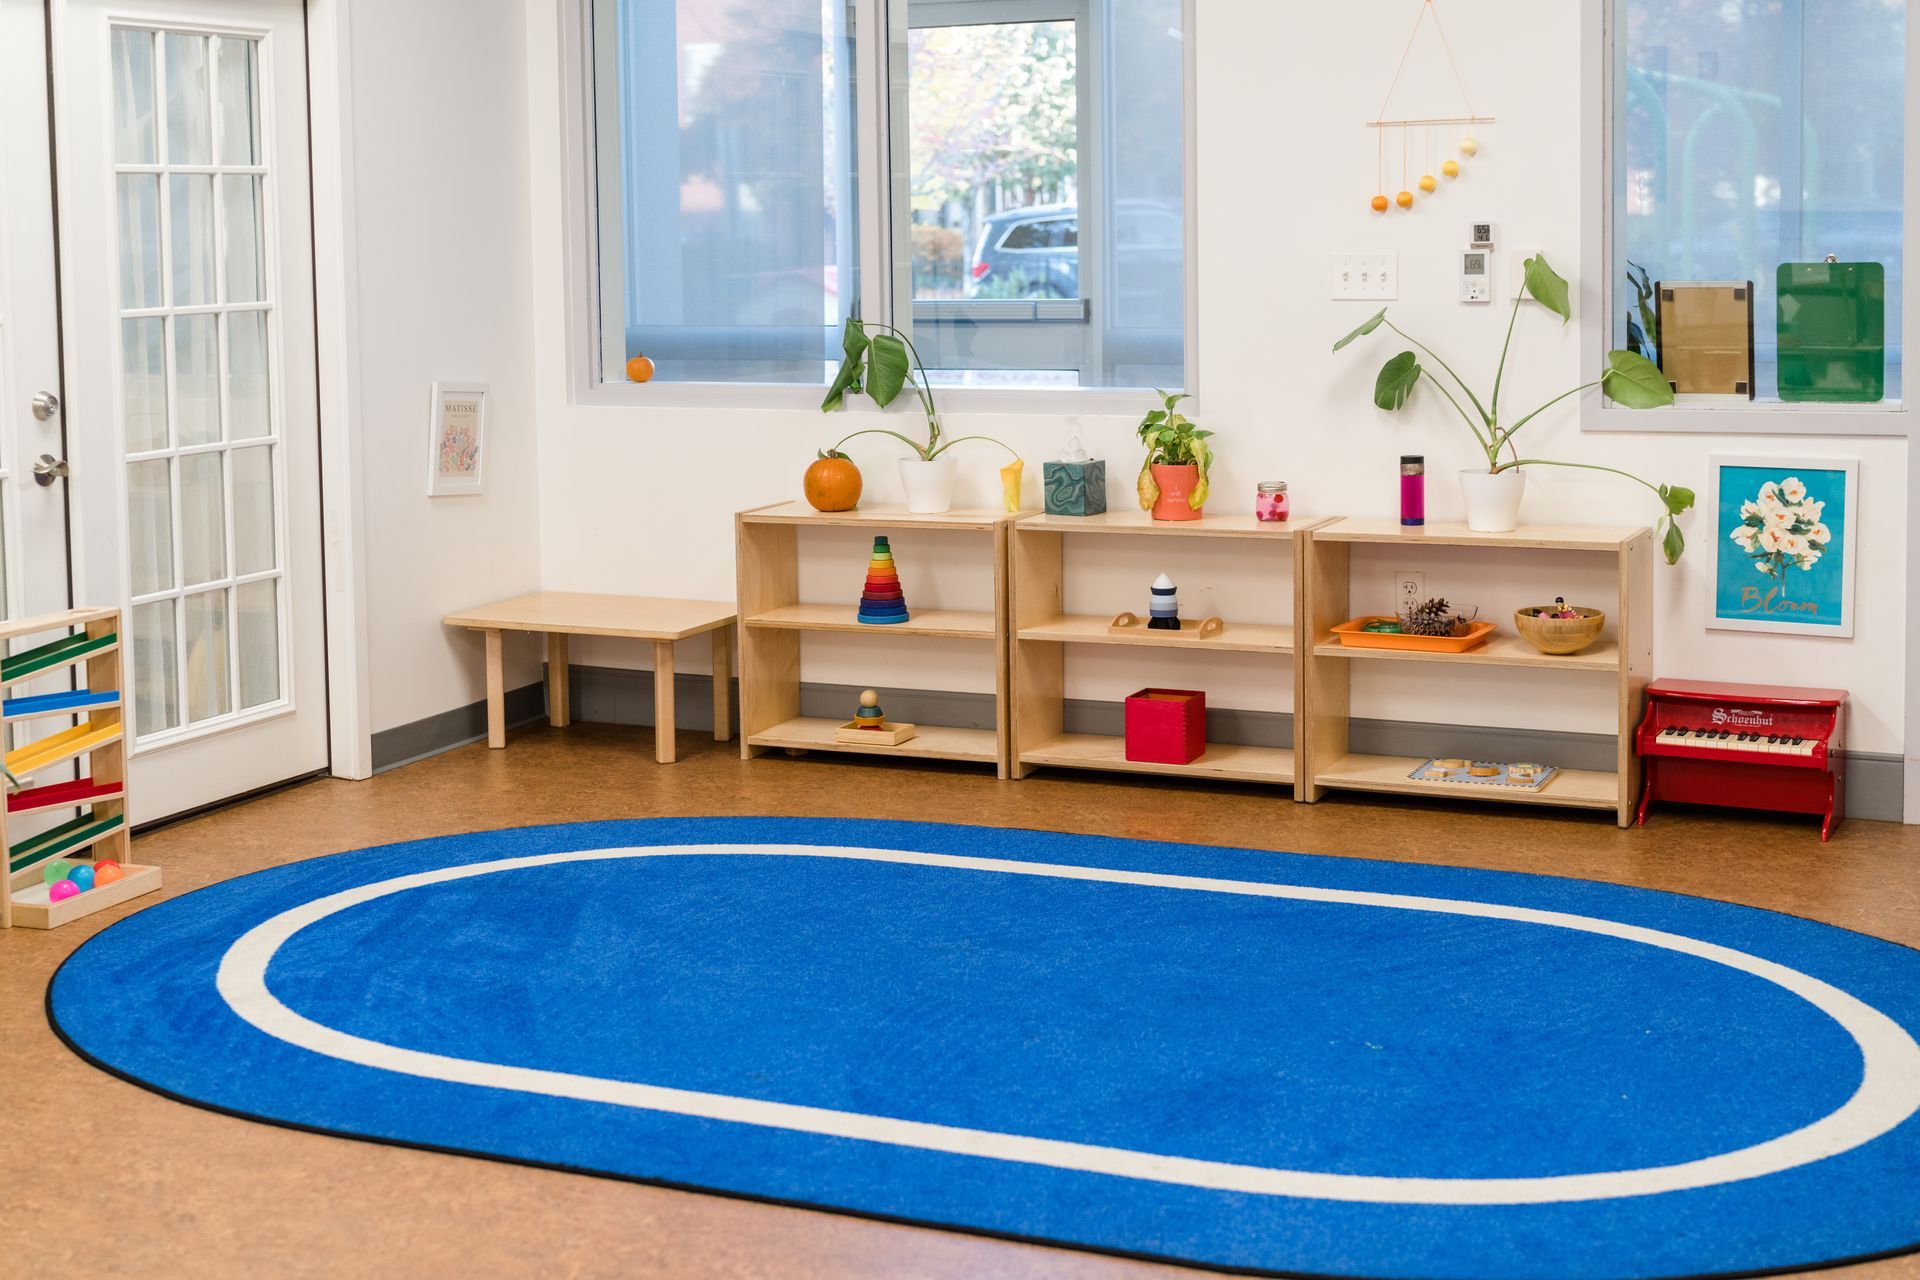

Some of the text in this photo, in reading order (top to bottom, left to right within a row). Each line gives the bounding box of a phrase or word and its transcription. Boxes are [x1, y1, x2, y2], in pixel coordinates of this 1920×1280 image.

[445, 404, 477, 413] MATISSE
[1741, 585, 1819, 615] Bloom
[1711, 707, 1774, 726] Schoenhut
